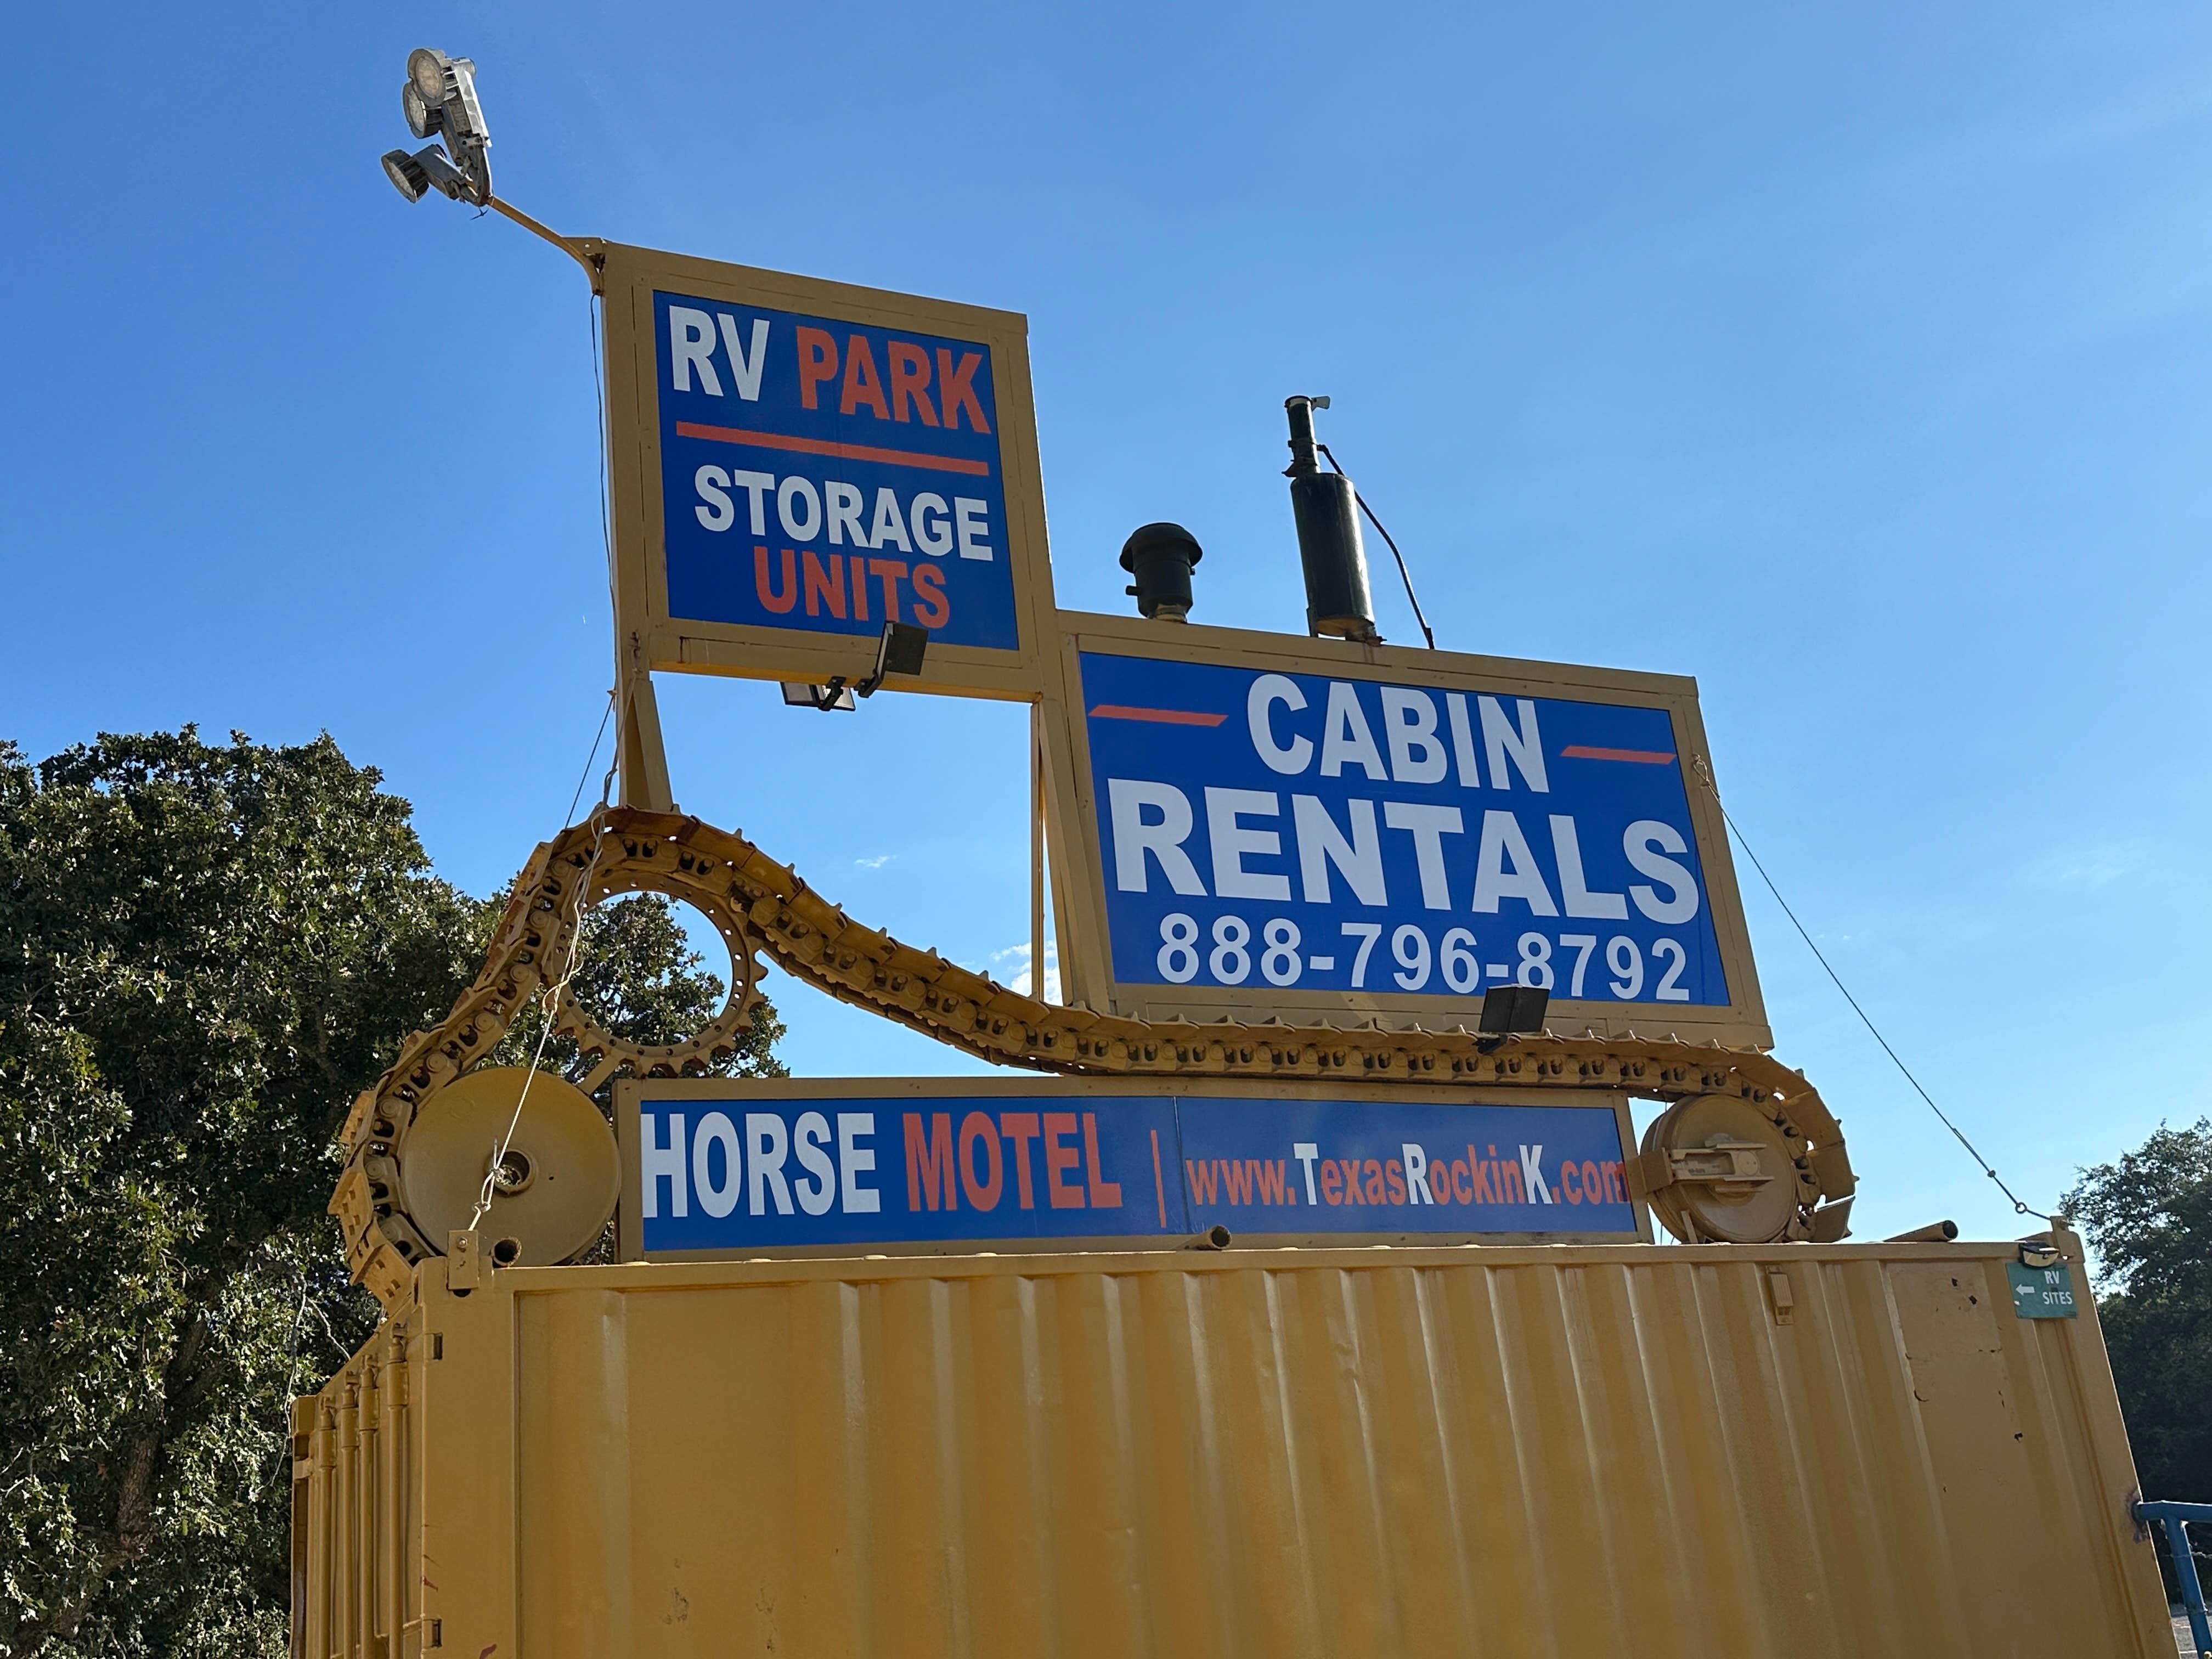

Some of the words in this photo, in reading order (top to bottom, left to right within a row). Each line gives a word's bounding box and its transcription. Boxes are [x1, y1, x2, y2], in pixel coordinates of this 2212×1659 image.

[669, 305, 770, 402] RV
[796, 325, 991, 435] PARK
[694, 465, 994, 561] STORAGE
[754, 546, 950, 629] UNITS
[1247, 674, 1549, 793] CABIN
[1107, 778, 1699, 924] RENTALS
[1156, 912, 1690, 1001] 888-796-8792
[641, 1111, 881, 1218] HORSE
[902, 1111, 1123, 1211] MOTEL
[1186, 1143, 1632, 1206] www.TexasRockinK.com
[2042, 1291, 2073, 1305] SITES
[2044, 1271, 2060, 1284] RV
